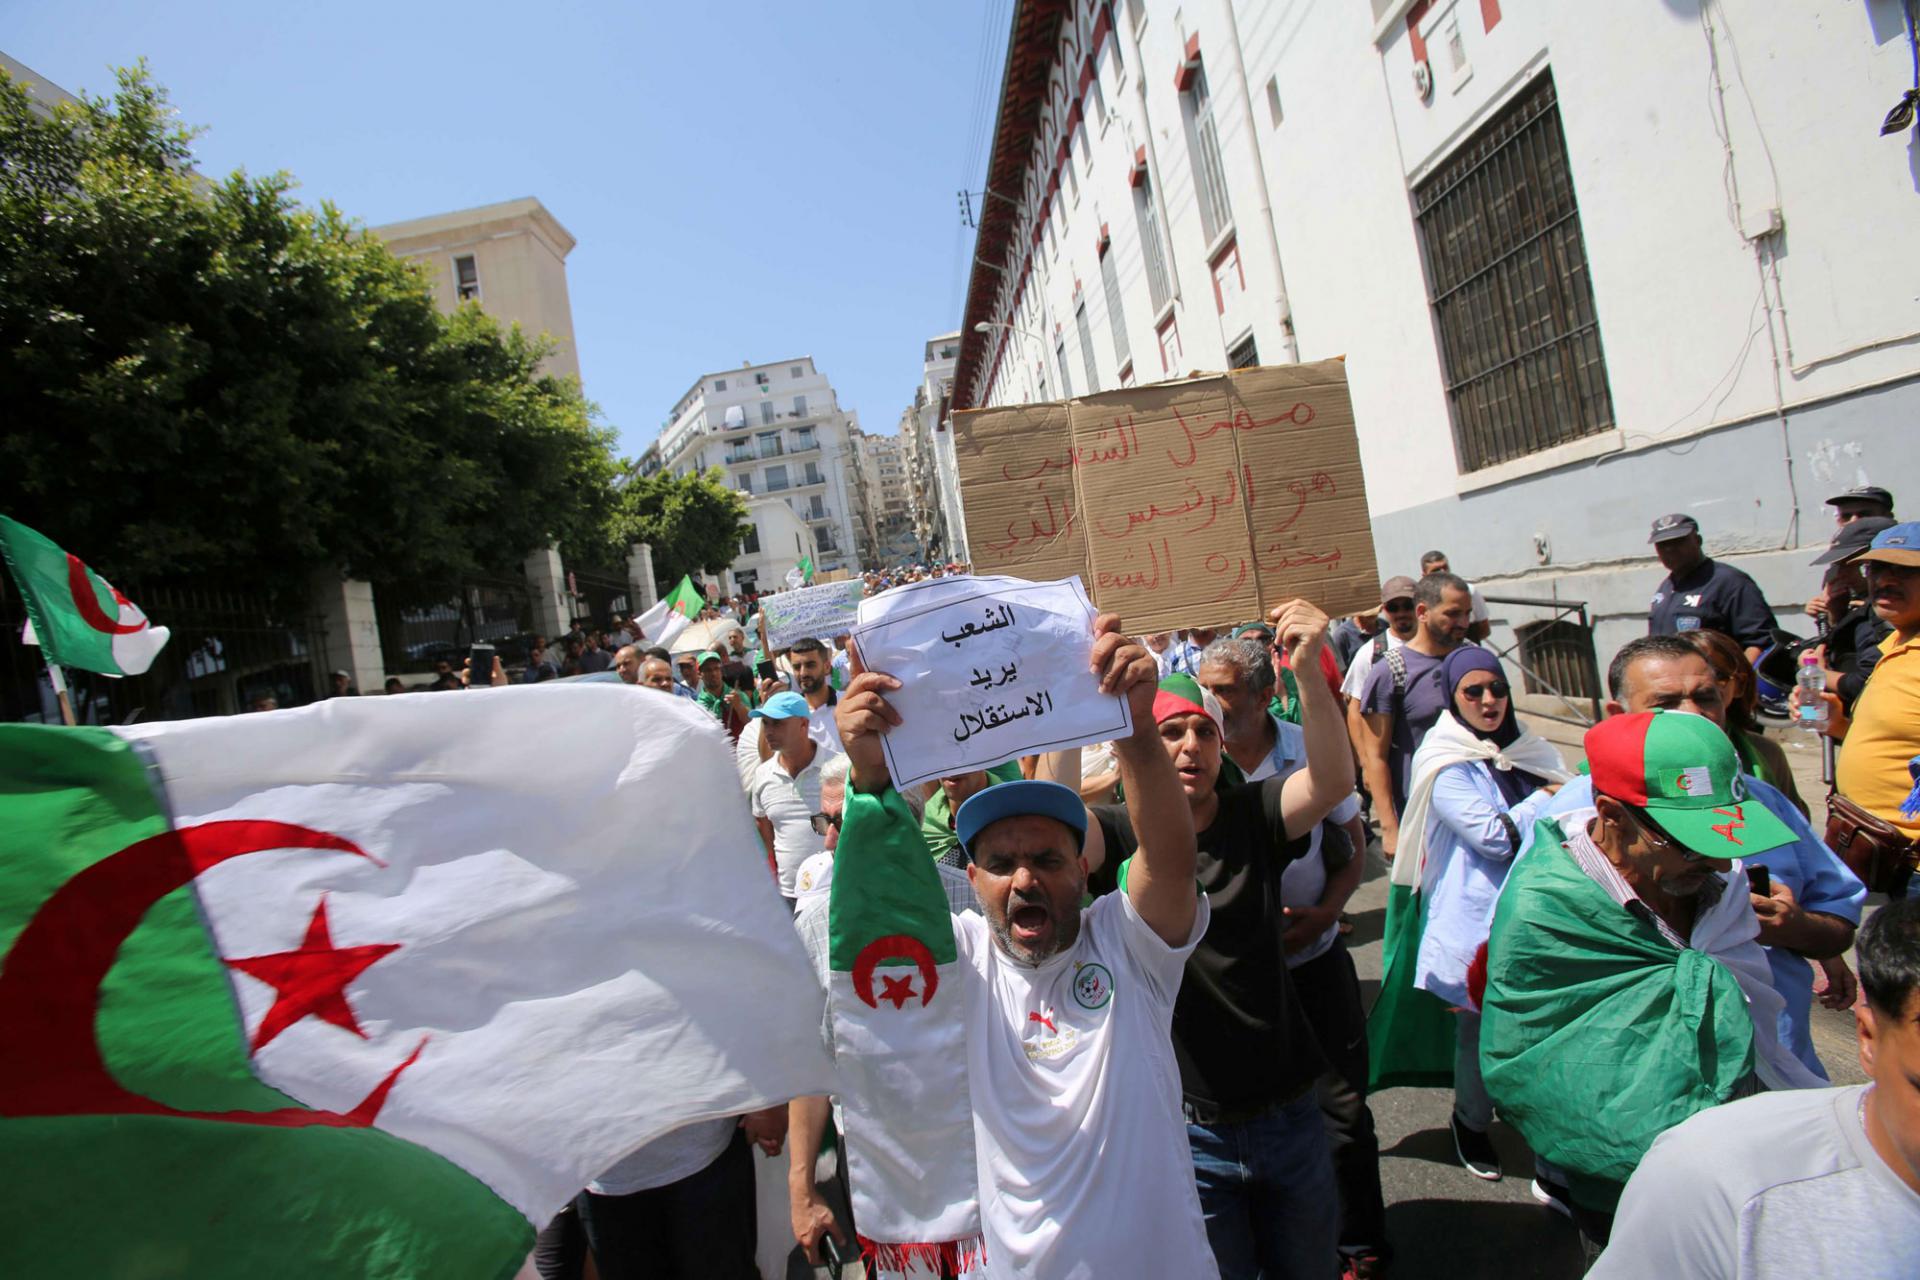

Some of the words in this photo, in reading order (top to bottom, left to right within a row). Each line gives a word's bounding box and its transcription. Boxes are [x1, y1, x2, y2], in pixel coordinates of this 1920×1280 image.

[1096, 463, 1256, 540] الرئيس
[1271, 471, 1337, 533] هو
[1094, 537, 1174, 591] الشع
[942, 603, 1016, 648] الشعب
[970, 661, 1017, 690] يريد
[954, 690, 1053, 742] الاستقلال
